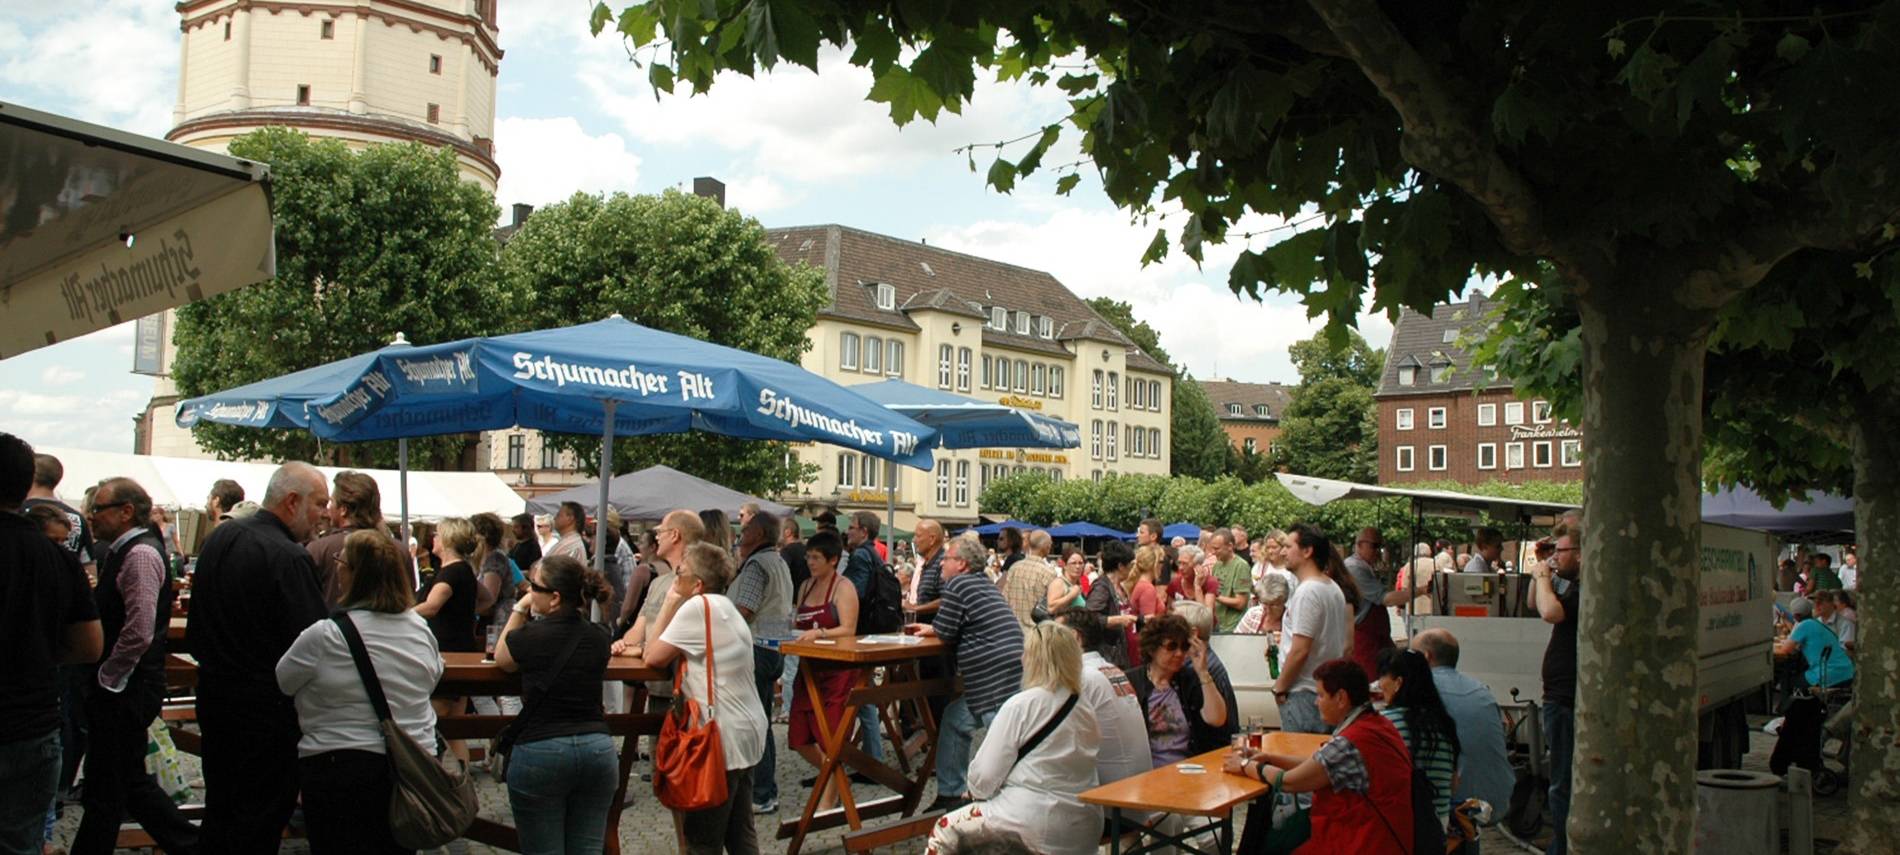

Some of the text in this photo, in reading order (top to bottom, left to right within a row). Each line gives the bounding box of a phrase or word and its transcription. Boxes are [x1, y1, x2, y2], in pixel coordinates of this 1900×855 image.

[396, 352, 475, 386] Schumacher Alt
[512, 352, 715, 401] Schumacher Alt
[757, 388, 919, 456] Schumacher Alt
